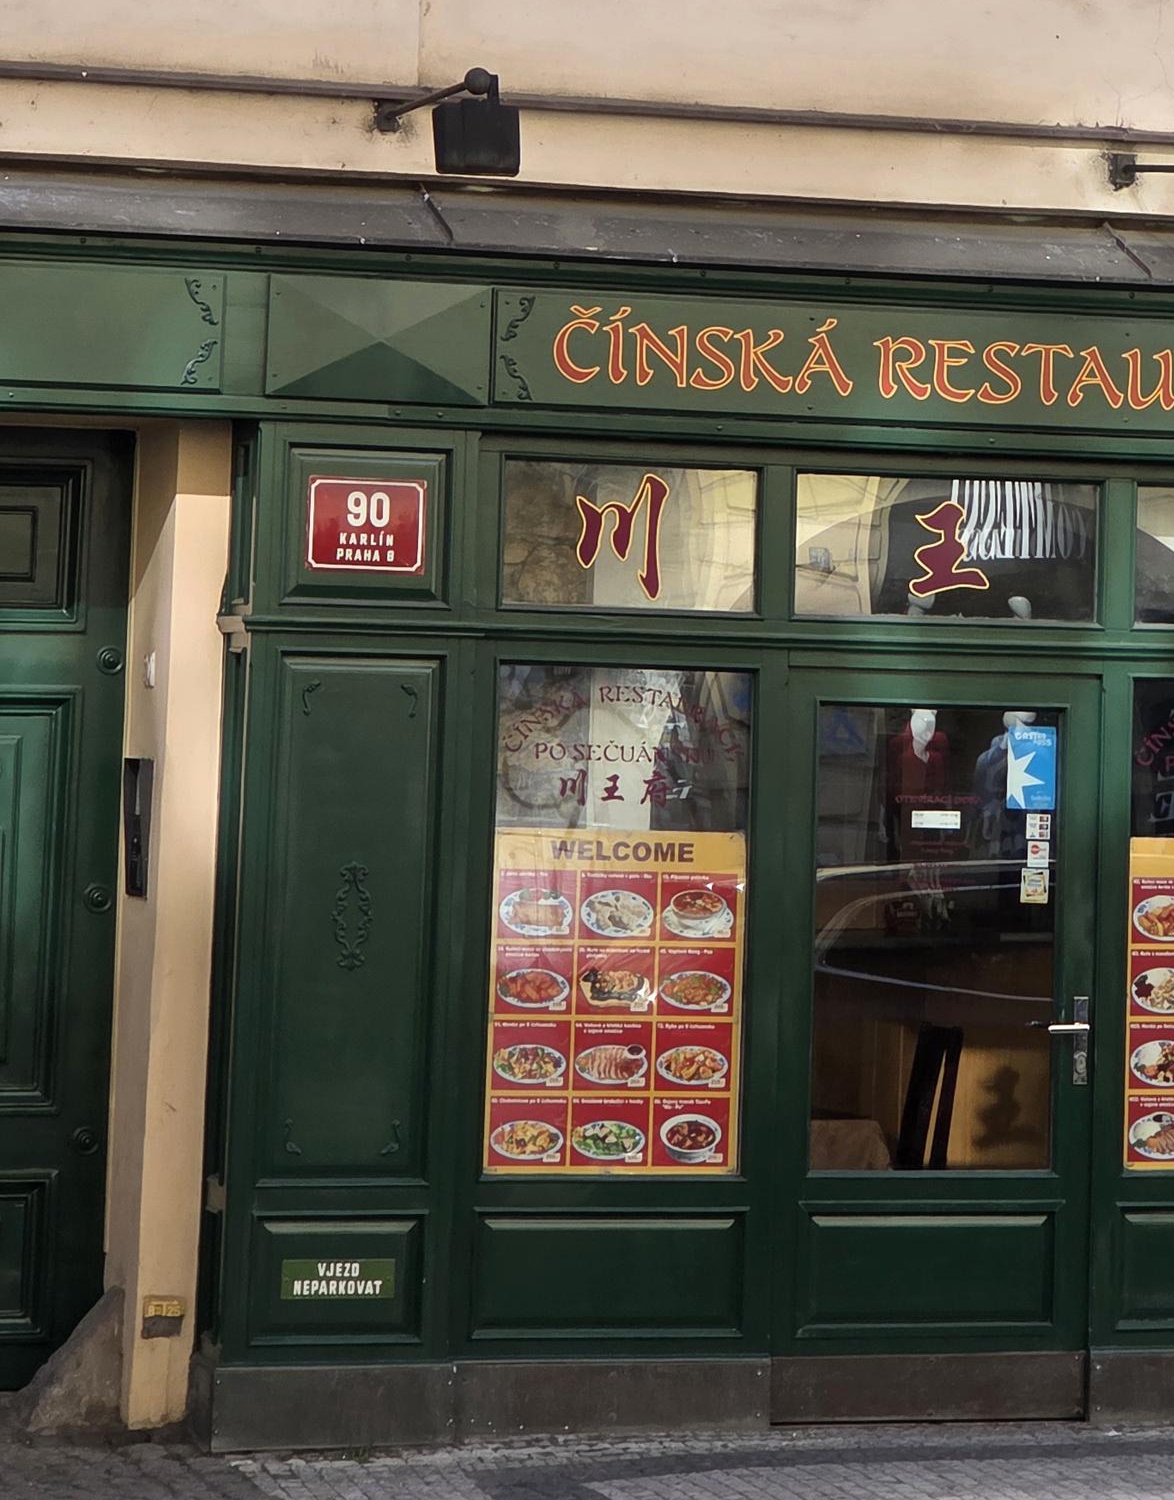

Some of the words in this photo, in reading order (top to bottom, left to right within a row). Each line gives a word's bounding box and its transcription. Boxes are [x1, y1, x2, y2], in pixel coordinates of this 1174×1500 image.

[552, 305, 854, 396] ČÍNSKÁ
[346, 490, 391, 528] 90
[339, 531, 394, 547] KARLÍN
[576, 473, 670, 601] 川
[908, 501, 991, 599] 王
[336, 548, 381, 562] PRAHA
[386, 550, 395, 562] 8
[534, 742, 566, 761] PO
[551, 840, 695, 863] WELCOME
[317, 1262, 360, 1277] VJEZD
[293, 1280, 383, 1296] NEPARKOVAT
